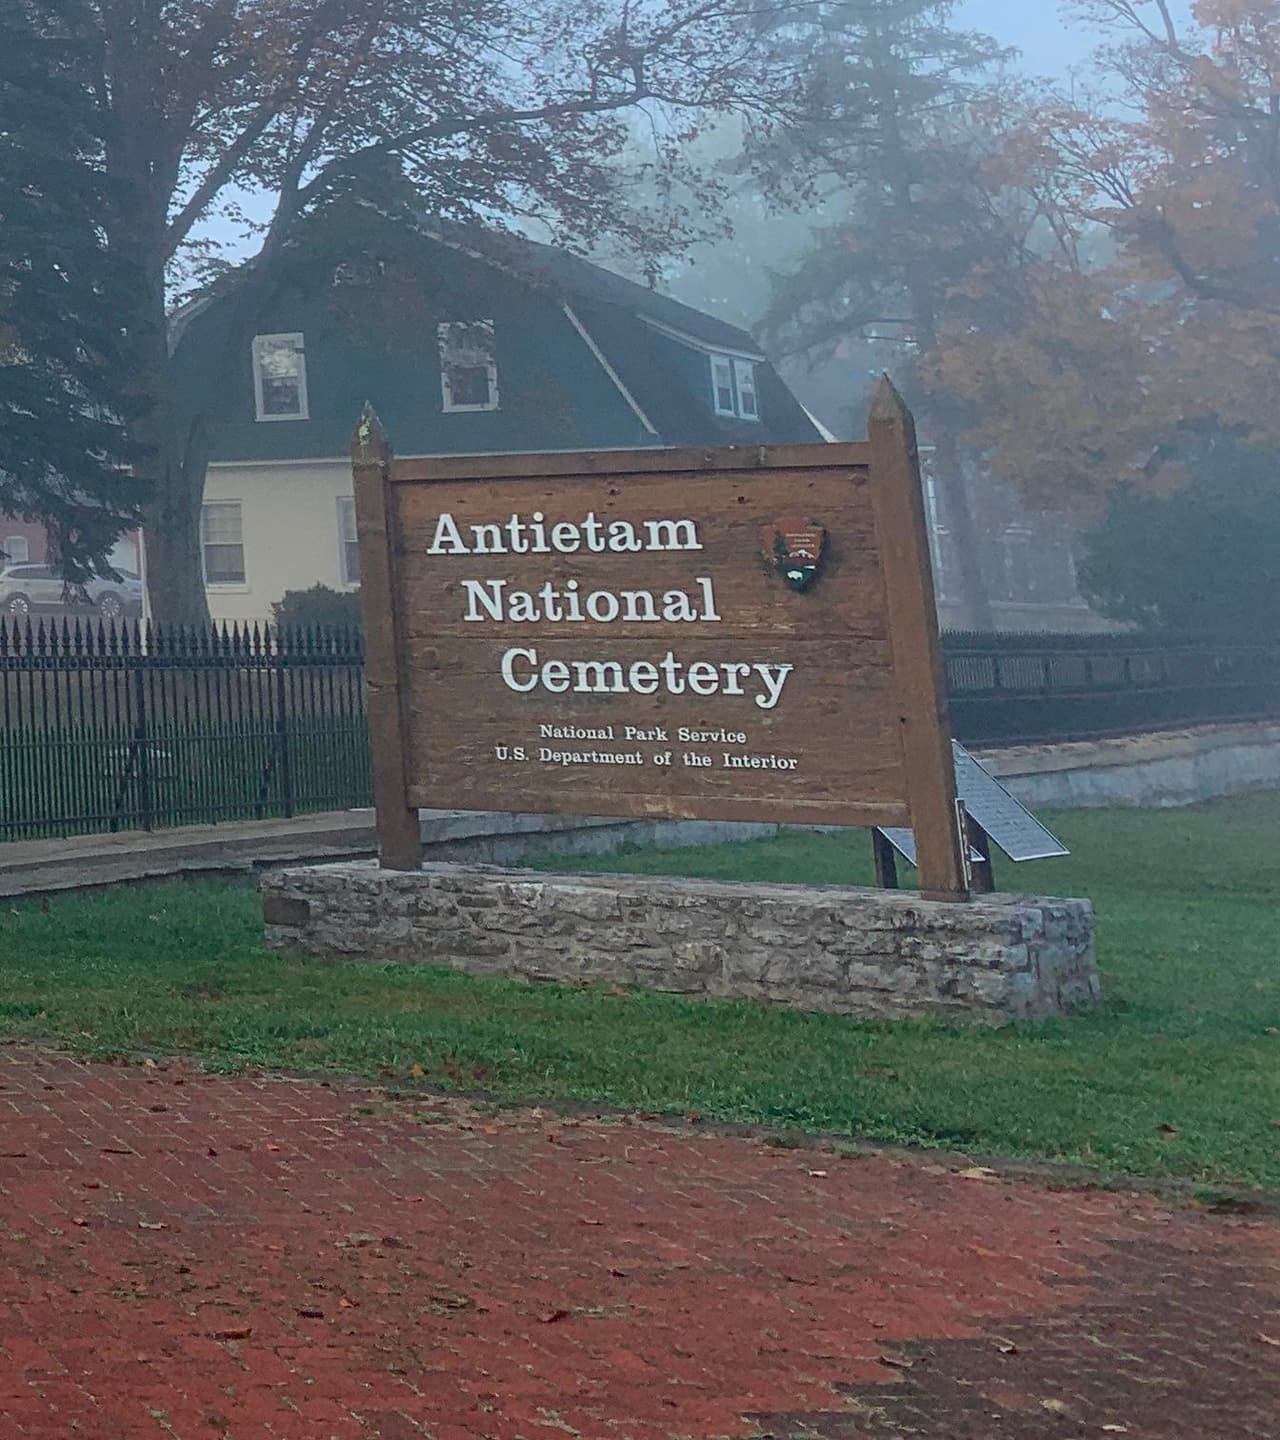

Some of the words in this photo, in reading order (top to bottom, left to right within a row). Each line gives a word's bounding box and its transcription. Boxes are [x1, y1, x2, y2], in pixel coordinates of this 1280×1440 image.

[426, 511, 703, 554] Antietam
[461, 577, 721, 622] National
[501, 647, 793, 709] Cemetery
[540, 724, 614, 740] National
[625, 726, 668, 742] Park
[678, 727, 747, 744] Service
[495, 746, 529, 761] U.S.
[539, 747, 643, 766] Department
[654, 751, 672, 766] of
[683, 752, 712, 767] the
[723, 756, 798, 770] Interior
